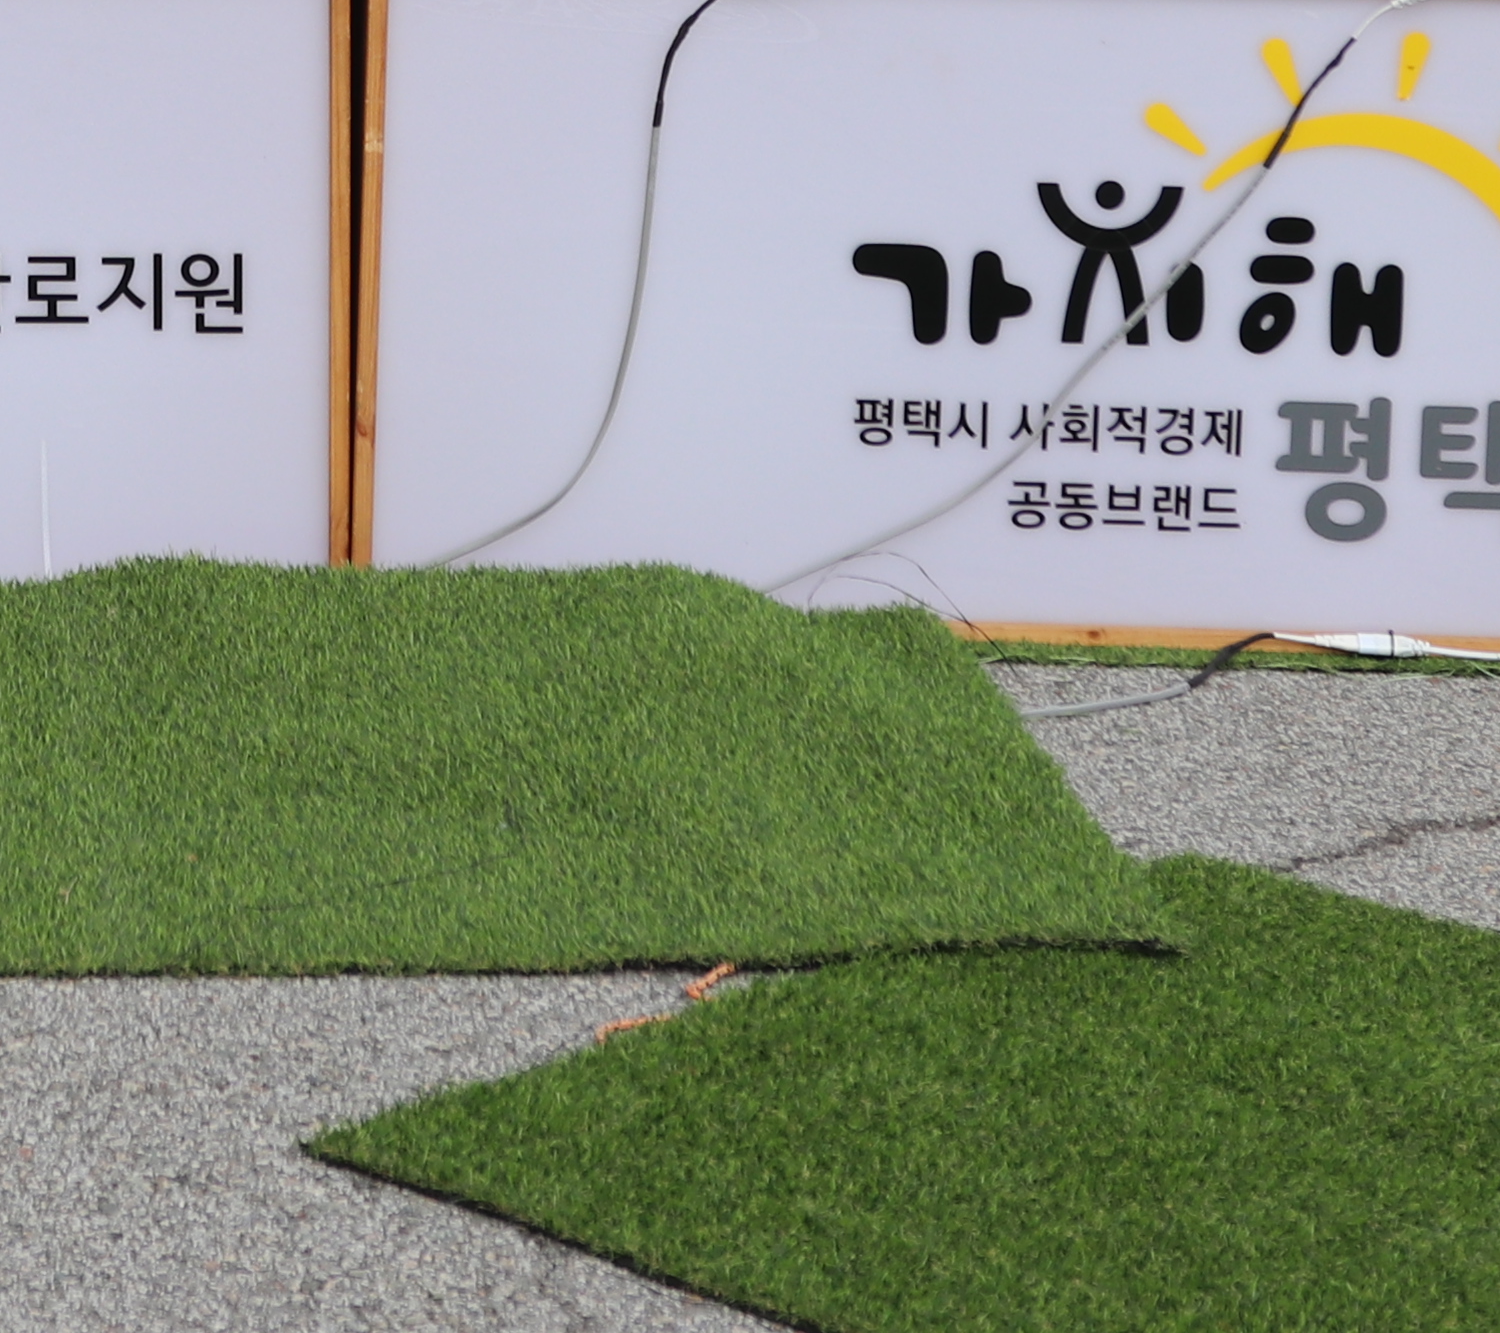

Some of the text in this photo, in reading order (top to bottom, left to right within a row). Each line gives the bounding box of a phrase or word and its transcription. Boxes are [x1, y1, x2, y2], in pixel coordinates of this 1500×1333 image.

[852, 398, 1245, 458] 평택시 사회적경제
[1006, 480, 1243, 533] 공동브랜드
